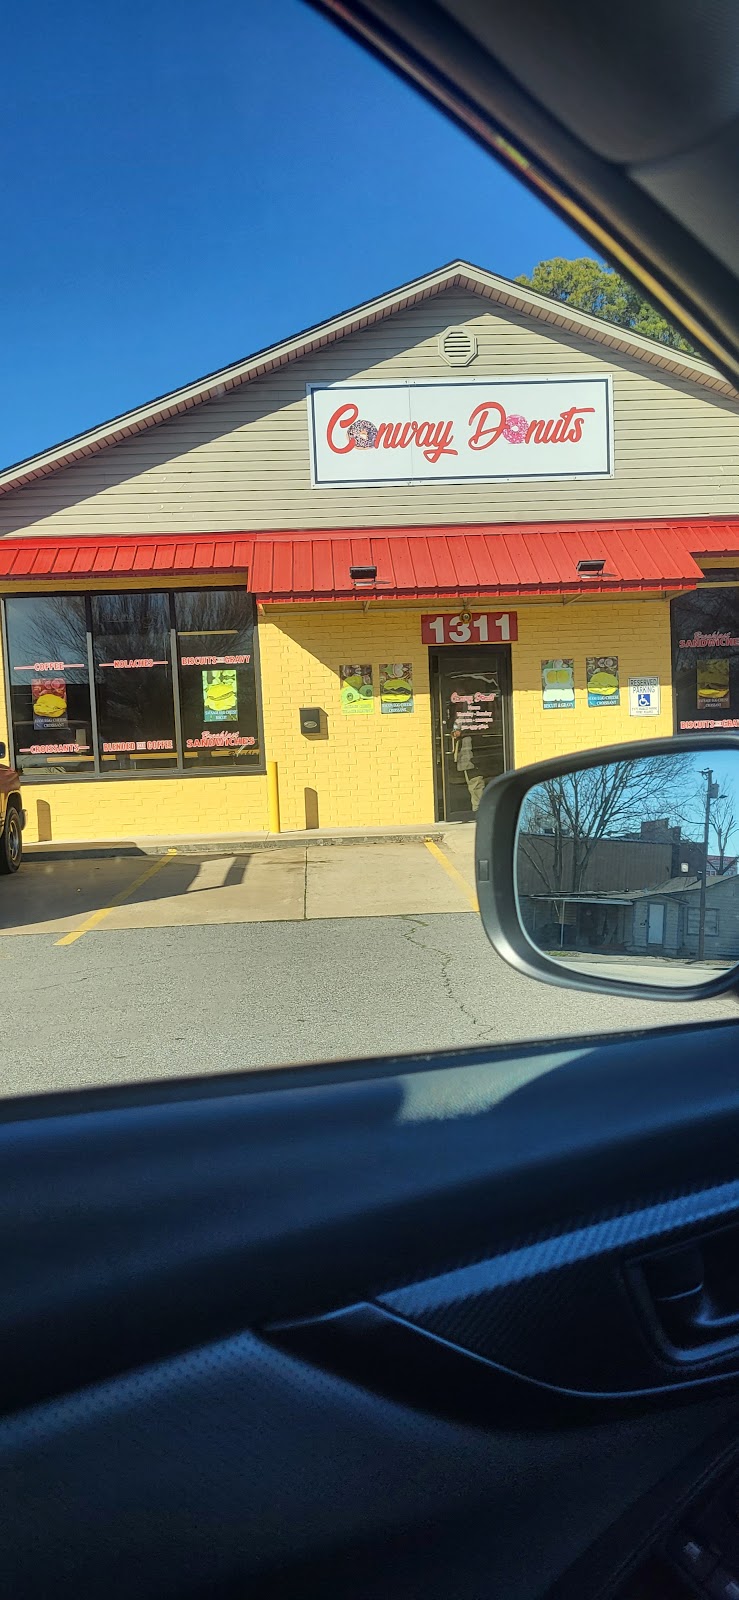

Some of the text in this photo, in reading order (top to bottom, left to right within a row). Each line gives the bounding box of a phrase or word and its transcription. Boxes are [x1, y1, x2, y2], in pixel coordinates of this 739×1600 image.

[326, 401, 595, 463] Conway Donuts
[429, 614, 510, 643] 1311
[114, 659, 153, 668] KOLACHES
[181, 656, 216, 665] BISCUITS
[225, 655, 250, 664] GRAVY
[34, 662, 64, 671] COFFEE
[630, 679, 657, 687] RESERVED
[633, 685, 656, 693] PARKING
[680, 720, 714, 729] BISCUITS
[201, 731, 239, 740] Breakfast
[102, 742, 135, 752] BLENDED
[146, 740, 173, 750] COFFEE
[186, 737, 255, 747] SANDWICHES
[29, 744, 80, 753] CROISSANTS
